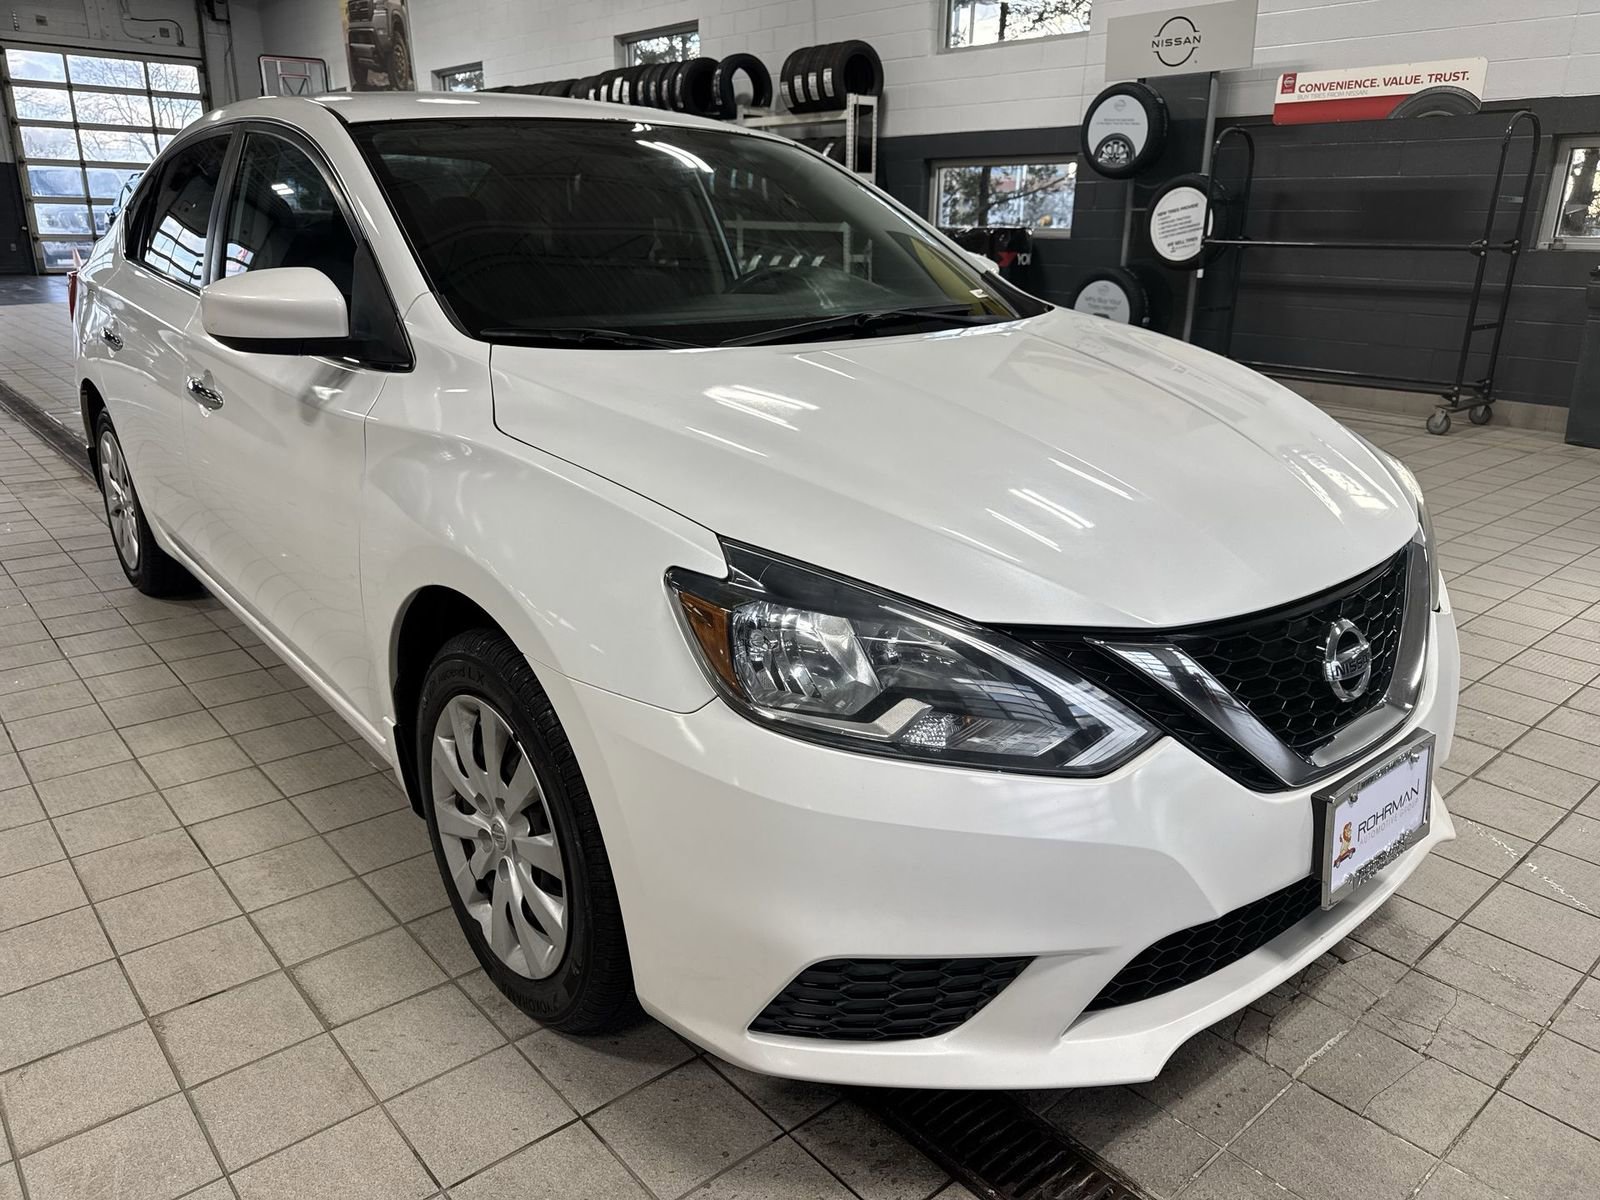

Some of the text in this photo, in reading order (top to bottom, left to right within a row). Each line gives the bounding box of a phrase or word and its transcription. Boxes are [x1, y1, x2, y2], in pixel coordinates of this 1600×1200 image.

[1151, 35, 1202, 48] NISSAN
[1298, 77, 1380, 93] CONVENIENCE.
[1382, 74, 1424, 87] VALUE.
[1427, 70, 1470, 83] TRUST.
[1357, 778, 1420, 842] ROHRMAN
[1360, 812, 1398, 846] AUTOMOTIVE
